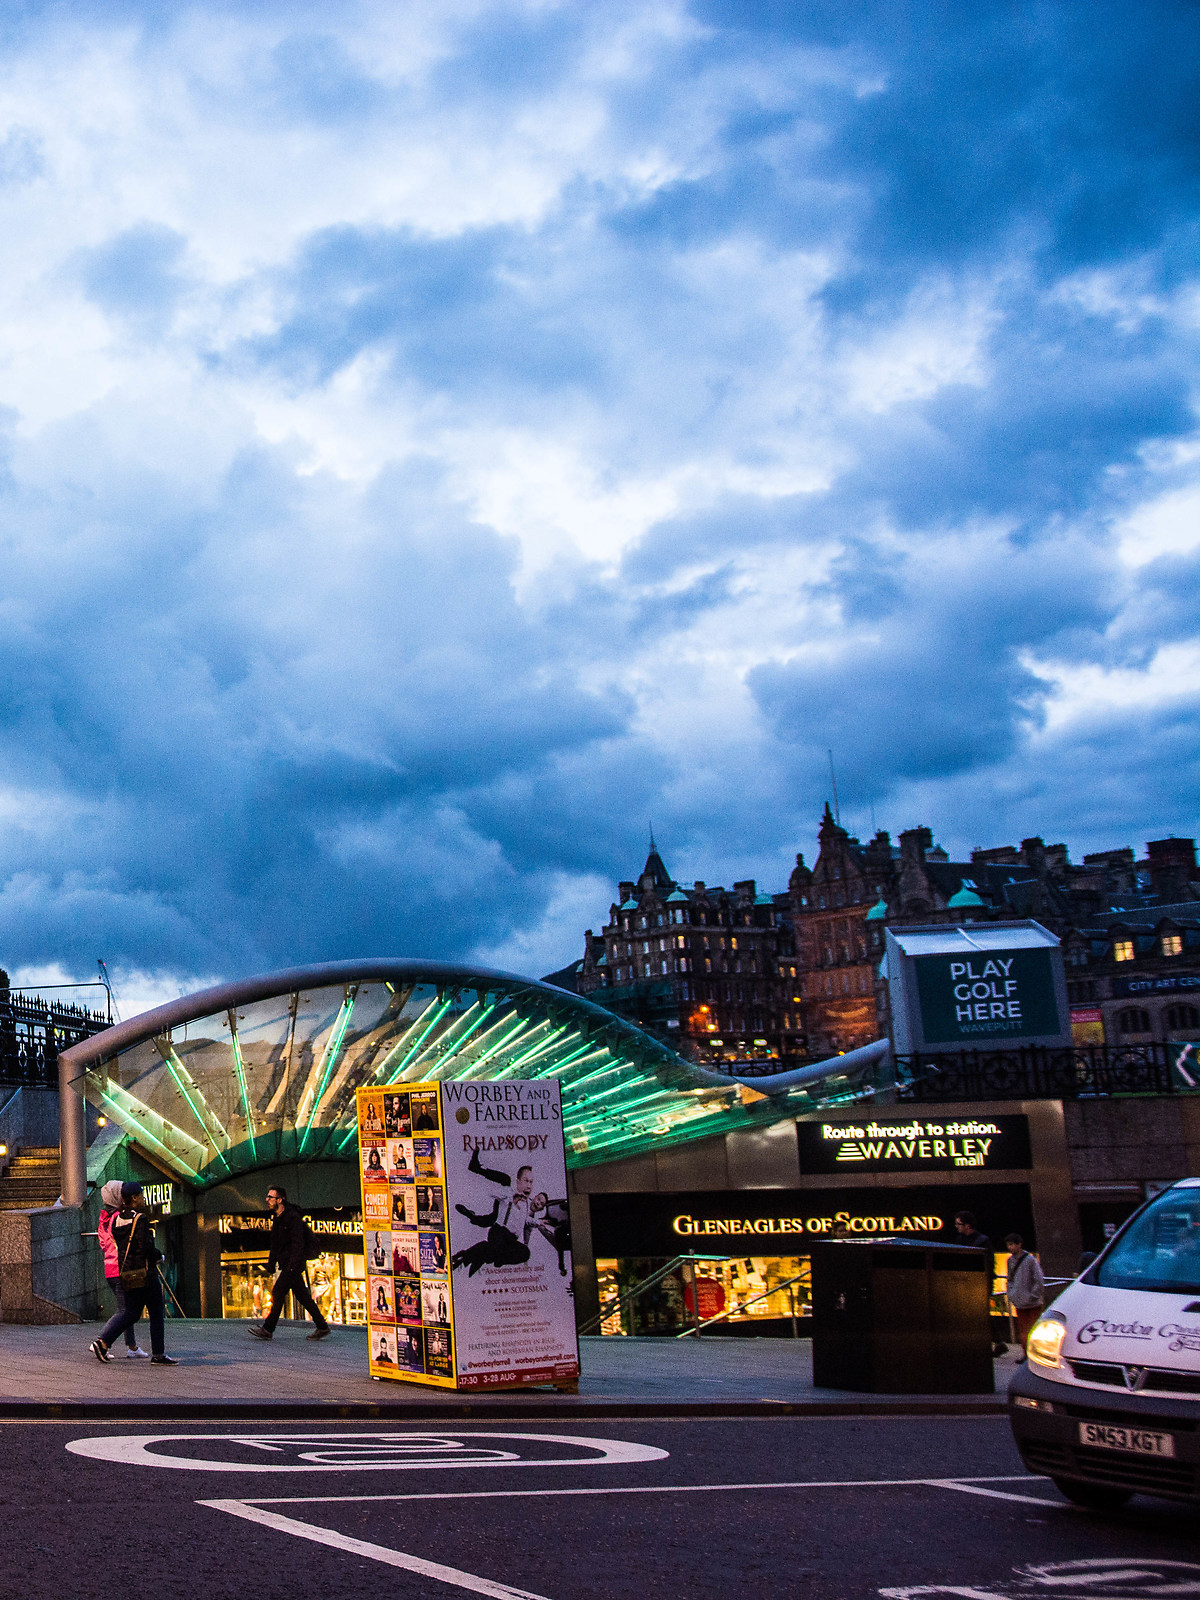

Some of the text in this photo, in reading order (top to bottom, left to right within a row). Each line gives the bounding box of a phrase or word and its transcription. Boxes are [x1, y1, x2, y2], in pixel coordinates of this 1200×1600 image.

[950, 958, 1014, 980] PLAY
[953, 980, 1018, 1001] GOLF
[1128, 981, 1153, 992] CITY
[1156, 978, 1176, 989] ART
[955, 1000, 1023, 1021] HERE
[959, 1020, 1023, 1033] WAVEPUTT
[443, 1083, 551, 1103] WORBEY AND
[474, 1100, 560, 1121] FARRELL'S
[822, 1121, 1002, 1141] Route through to station.
[462, 1134, 549, 1152] RHAPSODY
[858, 1138, 993, 1160] WAVERLEY
[954, 1152, 985, 1167] mall
[142, 1182, 174, 1207] AVERLEY
[365, 1193, 388, 1206] COMEDY
[365, 1205, 389, 1216] GALA 2016
[673, 1211, 944, 1236] GLENEAGLES OF SCOTLAND
[510, 1285, 548, 1293] SCOTSMAN
[1077, 1319, 1155, 1344] Gordon
[468, 1343, 500, 1351] FEATURING
[483, 1374, 499, 1383] 3-28
[1086, 1425, 1164, 1451] SN53 KGT
[229, 1437, 521, 1466] 20
